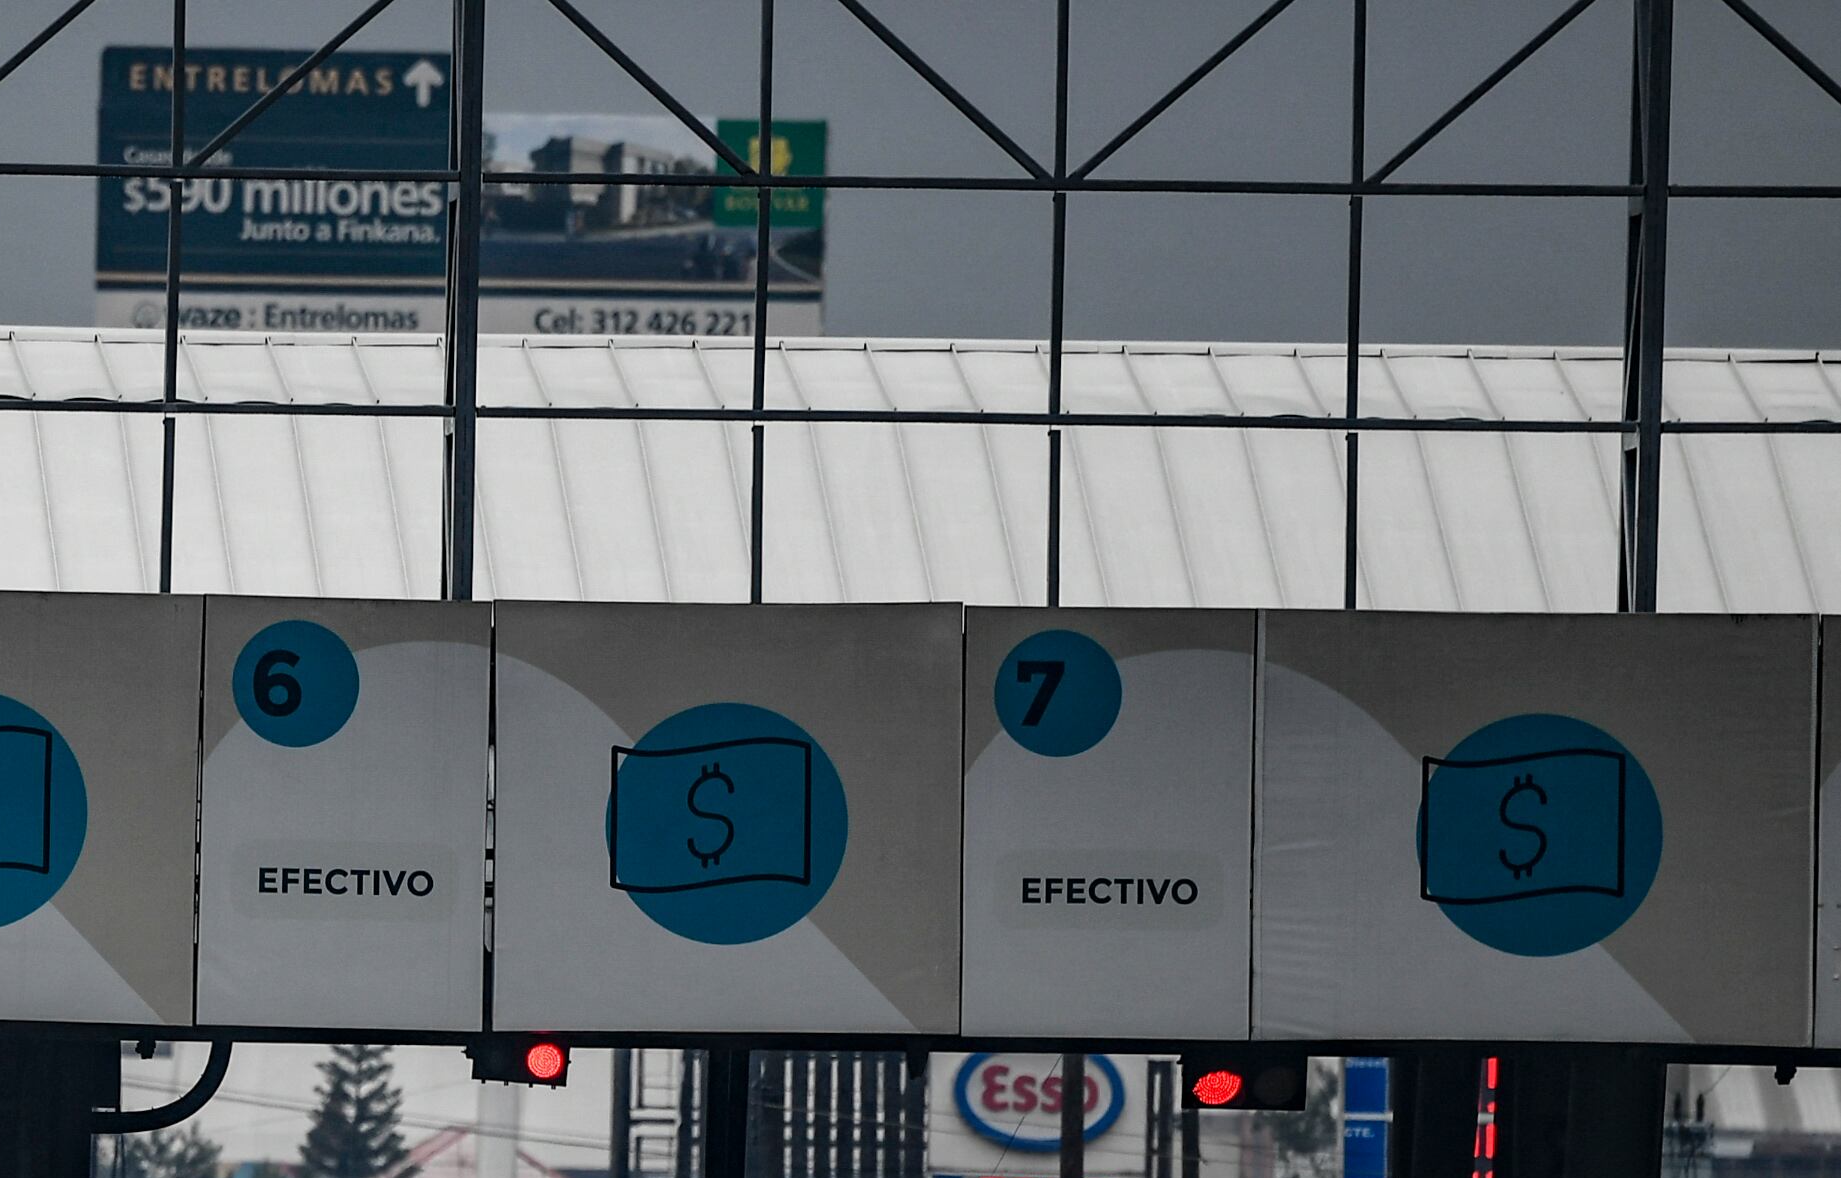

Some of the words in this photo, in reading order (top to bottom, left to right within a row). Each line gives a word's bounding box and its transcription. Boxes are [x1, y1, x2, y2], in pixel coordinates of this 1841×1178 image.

[129, 63, 394, 97] ENTRELOMAS
[242, 178, 444, 218] millones
[240, 217, 311, 243] Junto
[316, 223, 333, 242] a
[264, 301, 420, 332] Entrelomas
[534, 307, 583, 335] Cel:
[592, 309, 639, 336] 312
[647, 310, 697, 336] 426
[251, 649, 303, 718] 6
[1016, 661, 1066, 726] 7
[258, 867, 435, 897] EFECTIVO
[1021, 877, 1199, 906] EFECTIVO
[982, 1064, 1098, 1114] Esso
